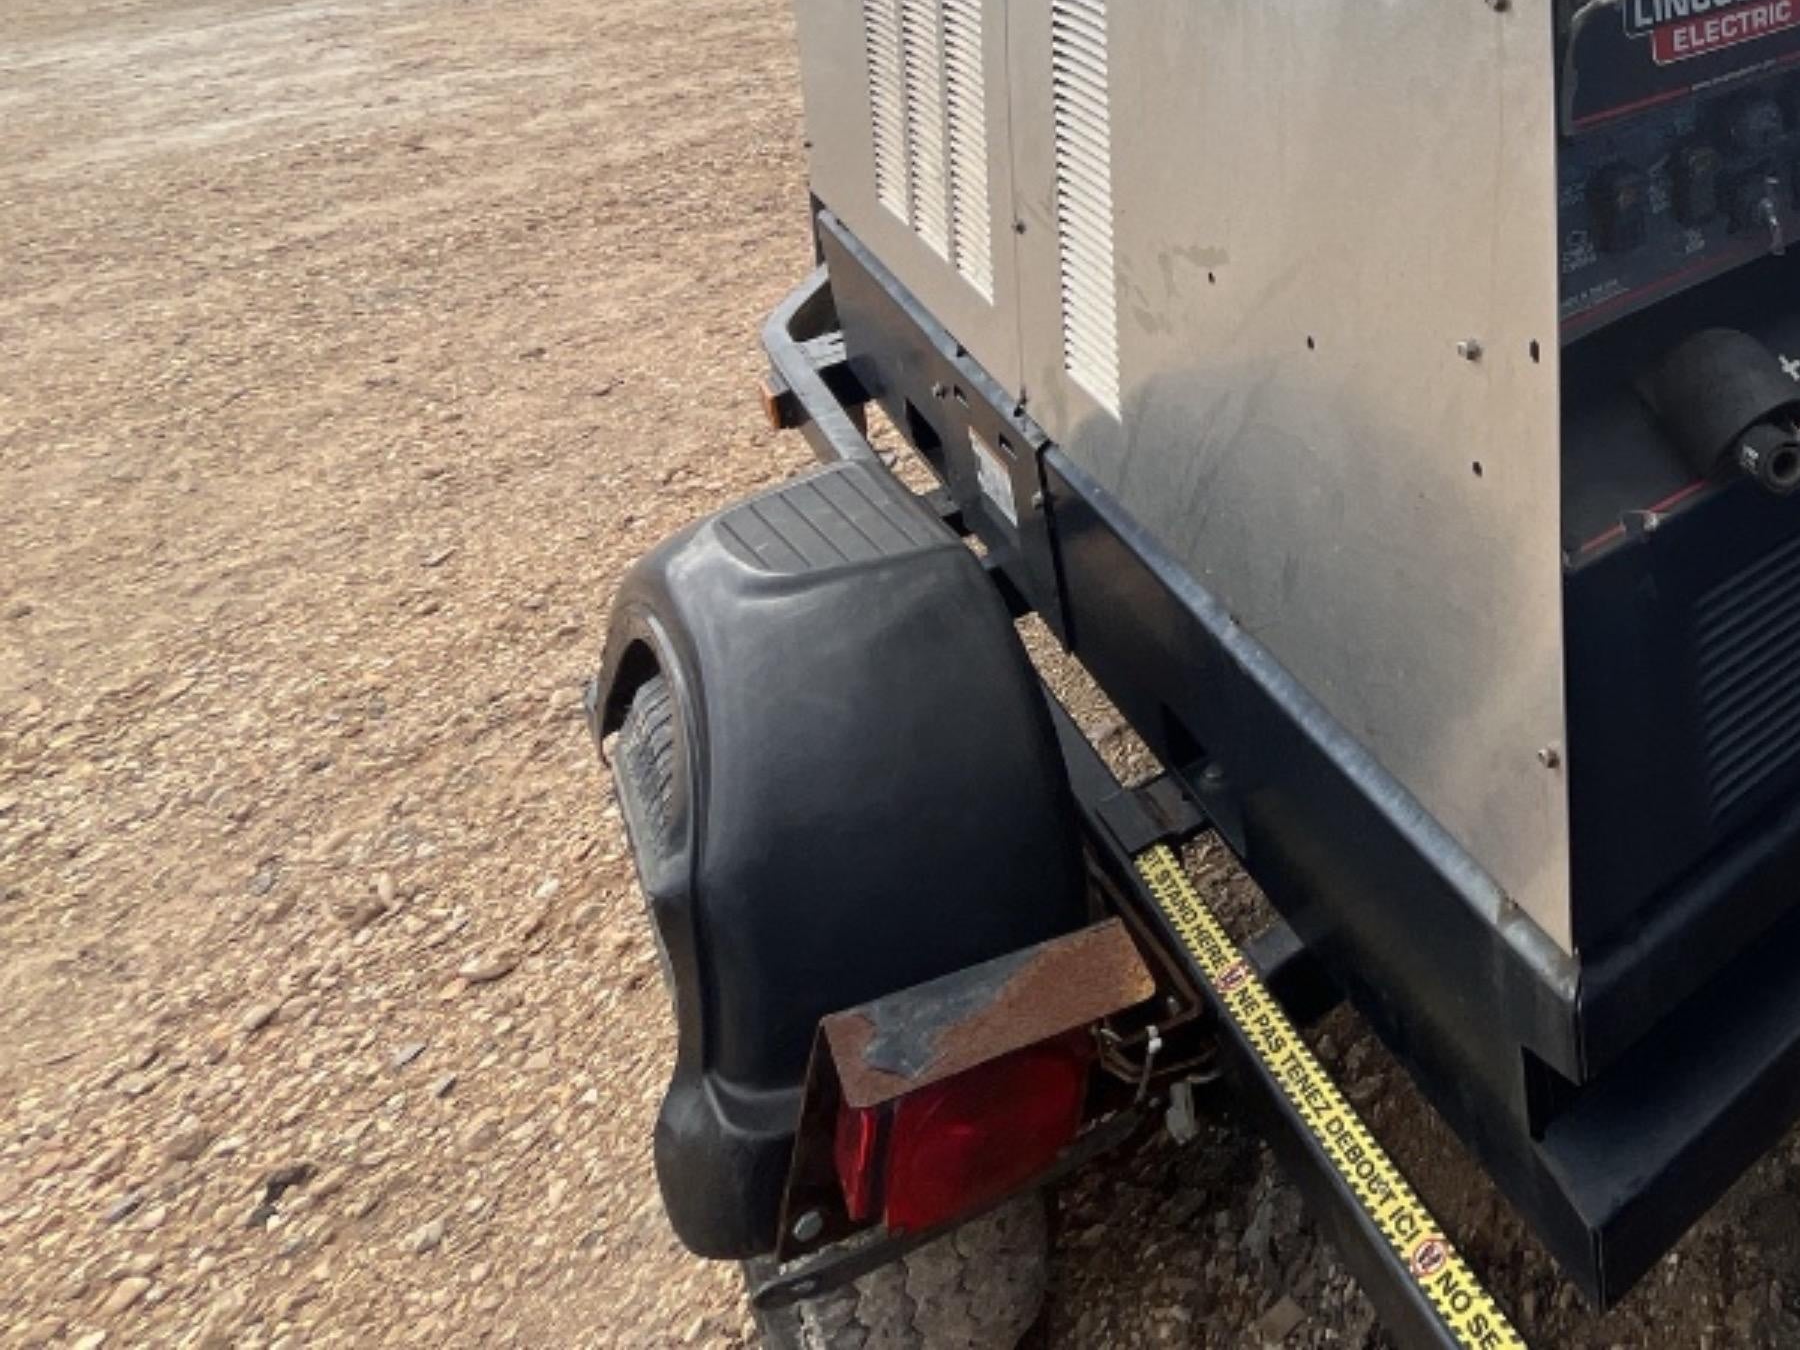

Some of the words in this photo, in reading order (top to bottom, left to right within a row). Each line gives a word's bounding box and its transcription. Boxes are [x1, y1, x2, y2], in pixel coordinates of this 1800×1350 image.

[1672, 0, 1793, 52] ELECTRIC
[1234, 987, 1260, 1016] NE
[1253, 1012, 1287, 1054] PAS
[1280, 1049, 1333, 1118] TENEZ
[1324, 1115, 1398, 1207] DEBOUT
[1388, 1205, 1423, 1243] ICI
[1434, 1270, 1473, 1314] NO
